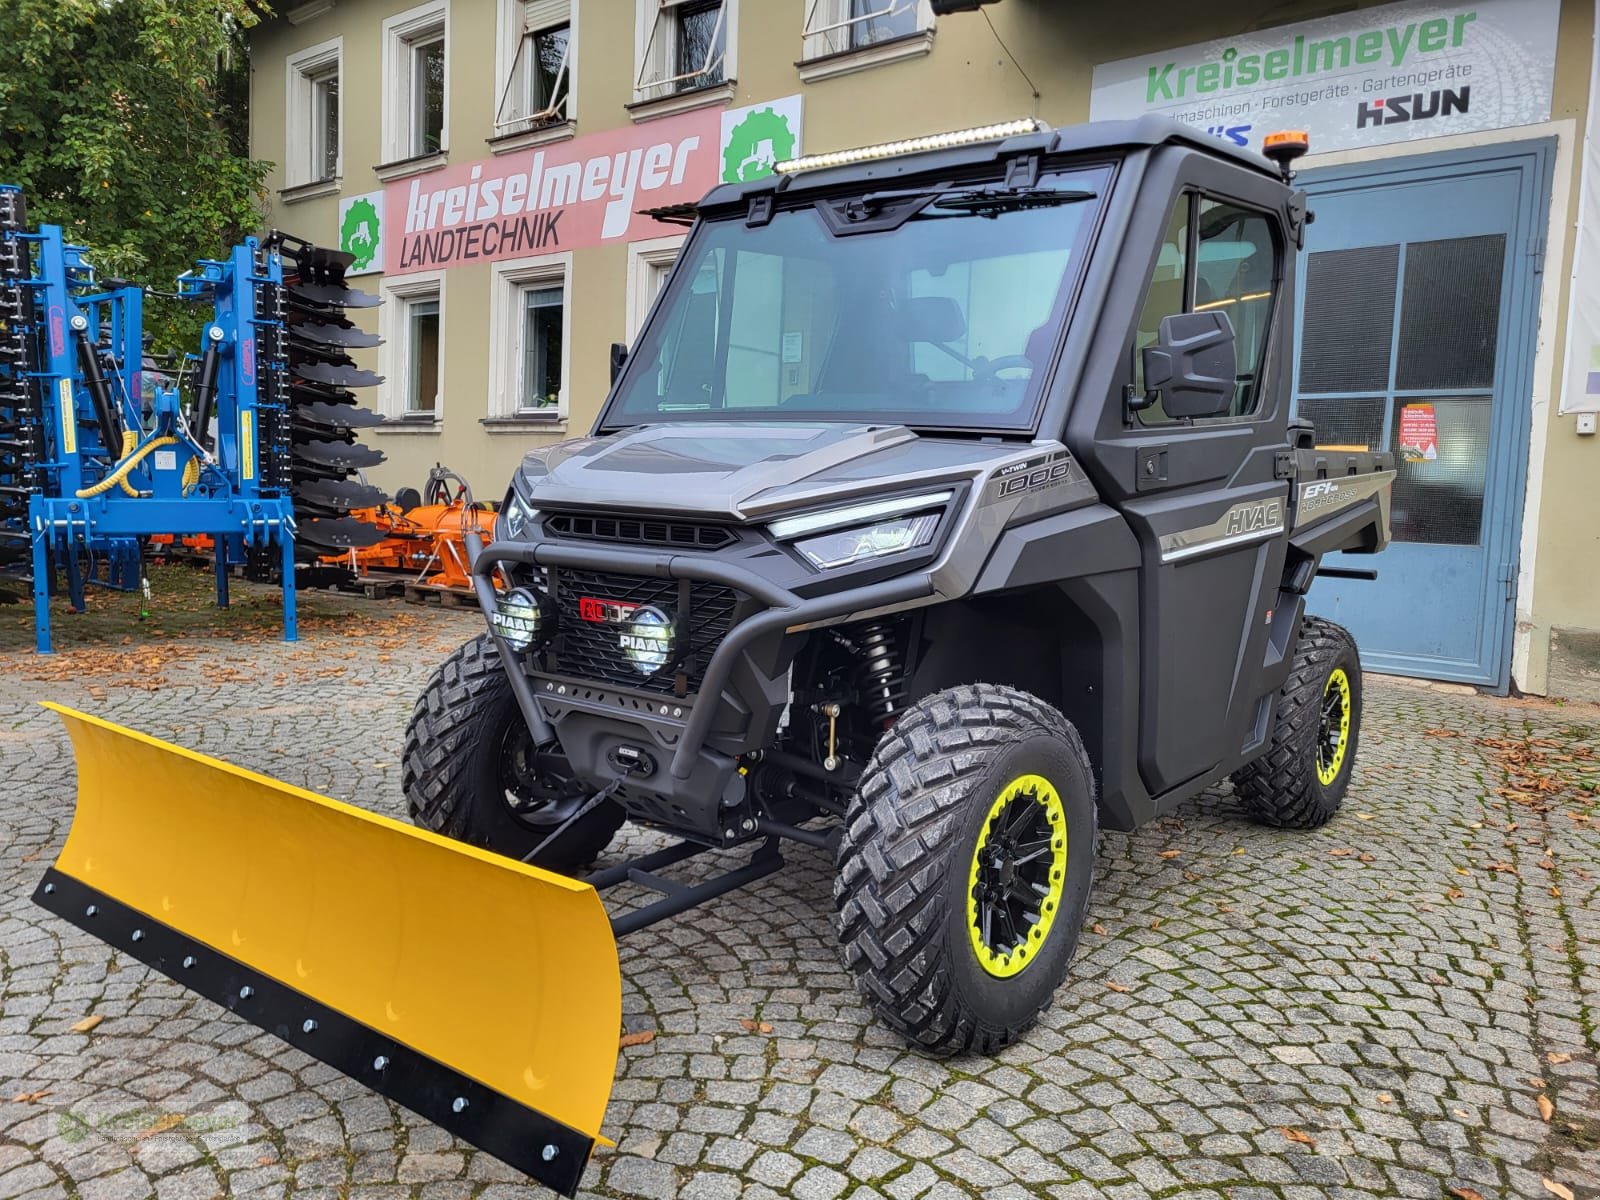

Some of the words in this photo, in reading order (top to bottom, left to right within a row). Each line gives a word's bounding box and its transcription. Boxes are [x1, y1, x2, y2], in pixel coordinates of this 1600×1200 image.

[1146, 11, 1477, 103] Kreiselmeyer
[1262, 85, 1350, 110] Forstgeräte
[1362, 64, 1473, 93] Gartengeräte
[403, 135, 700, 239] kreiselmeyer
[399, 209, 565, 269] LANDTECHNIK
[998, 460, 1071, 498] 1000
[1225, 502, 1279, 536] HVAC
[620, 635, 660, 652] PIAA
